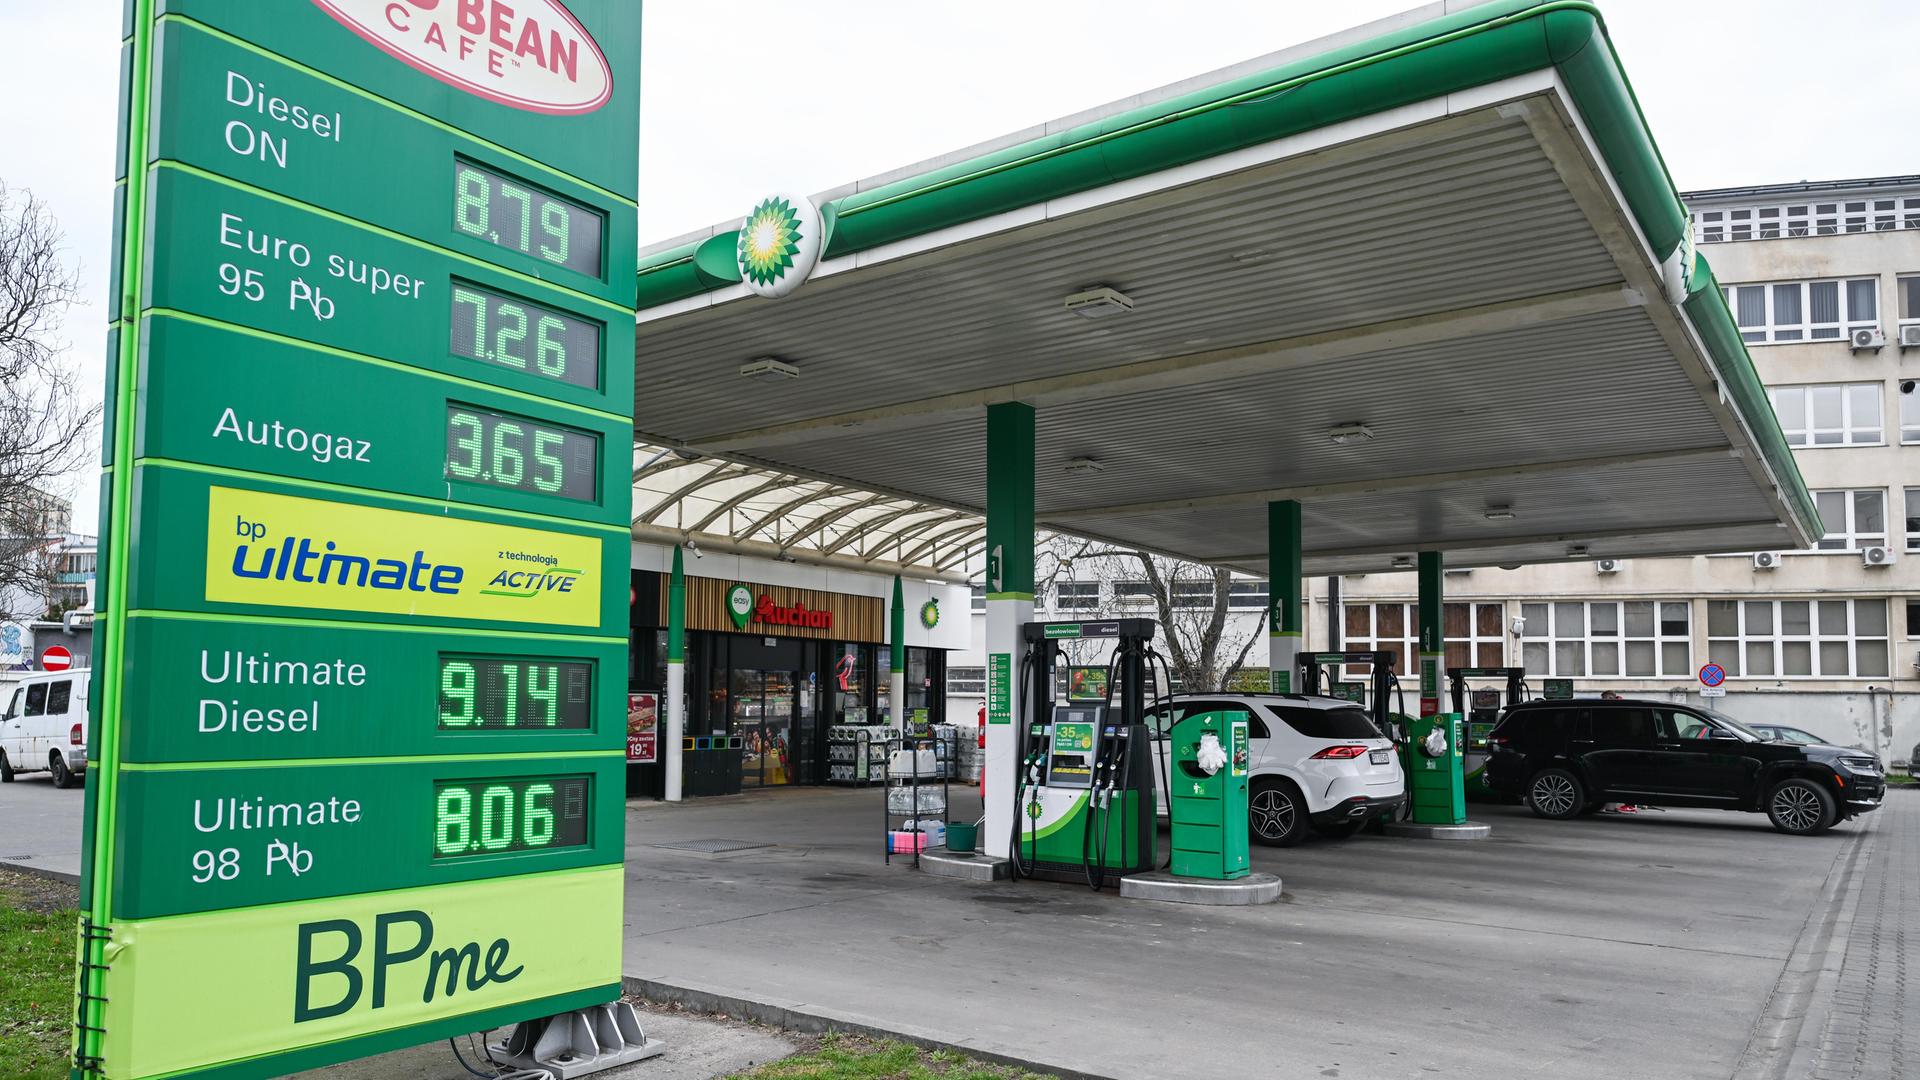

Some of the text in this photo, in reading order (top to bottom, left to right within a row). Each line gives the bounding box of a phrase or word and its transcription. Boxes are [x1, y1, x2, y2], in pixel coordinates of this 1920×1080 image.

[457, 0, 578, 84] BEAN
[226, 70, 341, 143] Diesel
[225, 119, 288, 169] ON
[457, 169, 569, 264] 8.79
[220, 213, 426, 299] Euro super
[219, 263, 336, 321] 95 Pb
[455, 289, 567, 378] 7.26
[212, 407, 371, 464] Autogaz
[449, 413, 564, 492] 3.65
[236, 516, 266, 542] bp
[232, 536, 464, 595] ultimate
[489, 569, 577, 593] ACTIVE
[498, 550, 559, 567] z technologią
[991, 560, 996, 574] 1
[733, 597, 750, 607] easy
[753, 594, 833, 629] Auchan
[201, 650, 366, 686] Ultimate
[441, 662, 558, 727] 9.14
[199, 700, 318, 733] Diesel
[630, 743, 642, 756] 19
[194, 796, 361, 833] Ultimate
[437, 784, 555, 853] 8.06
[192, 839, 313, 883] 98 Pb
[293, 910, 525, 1024] BPme
